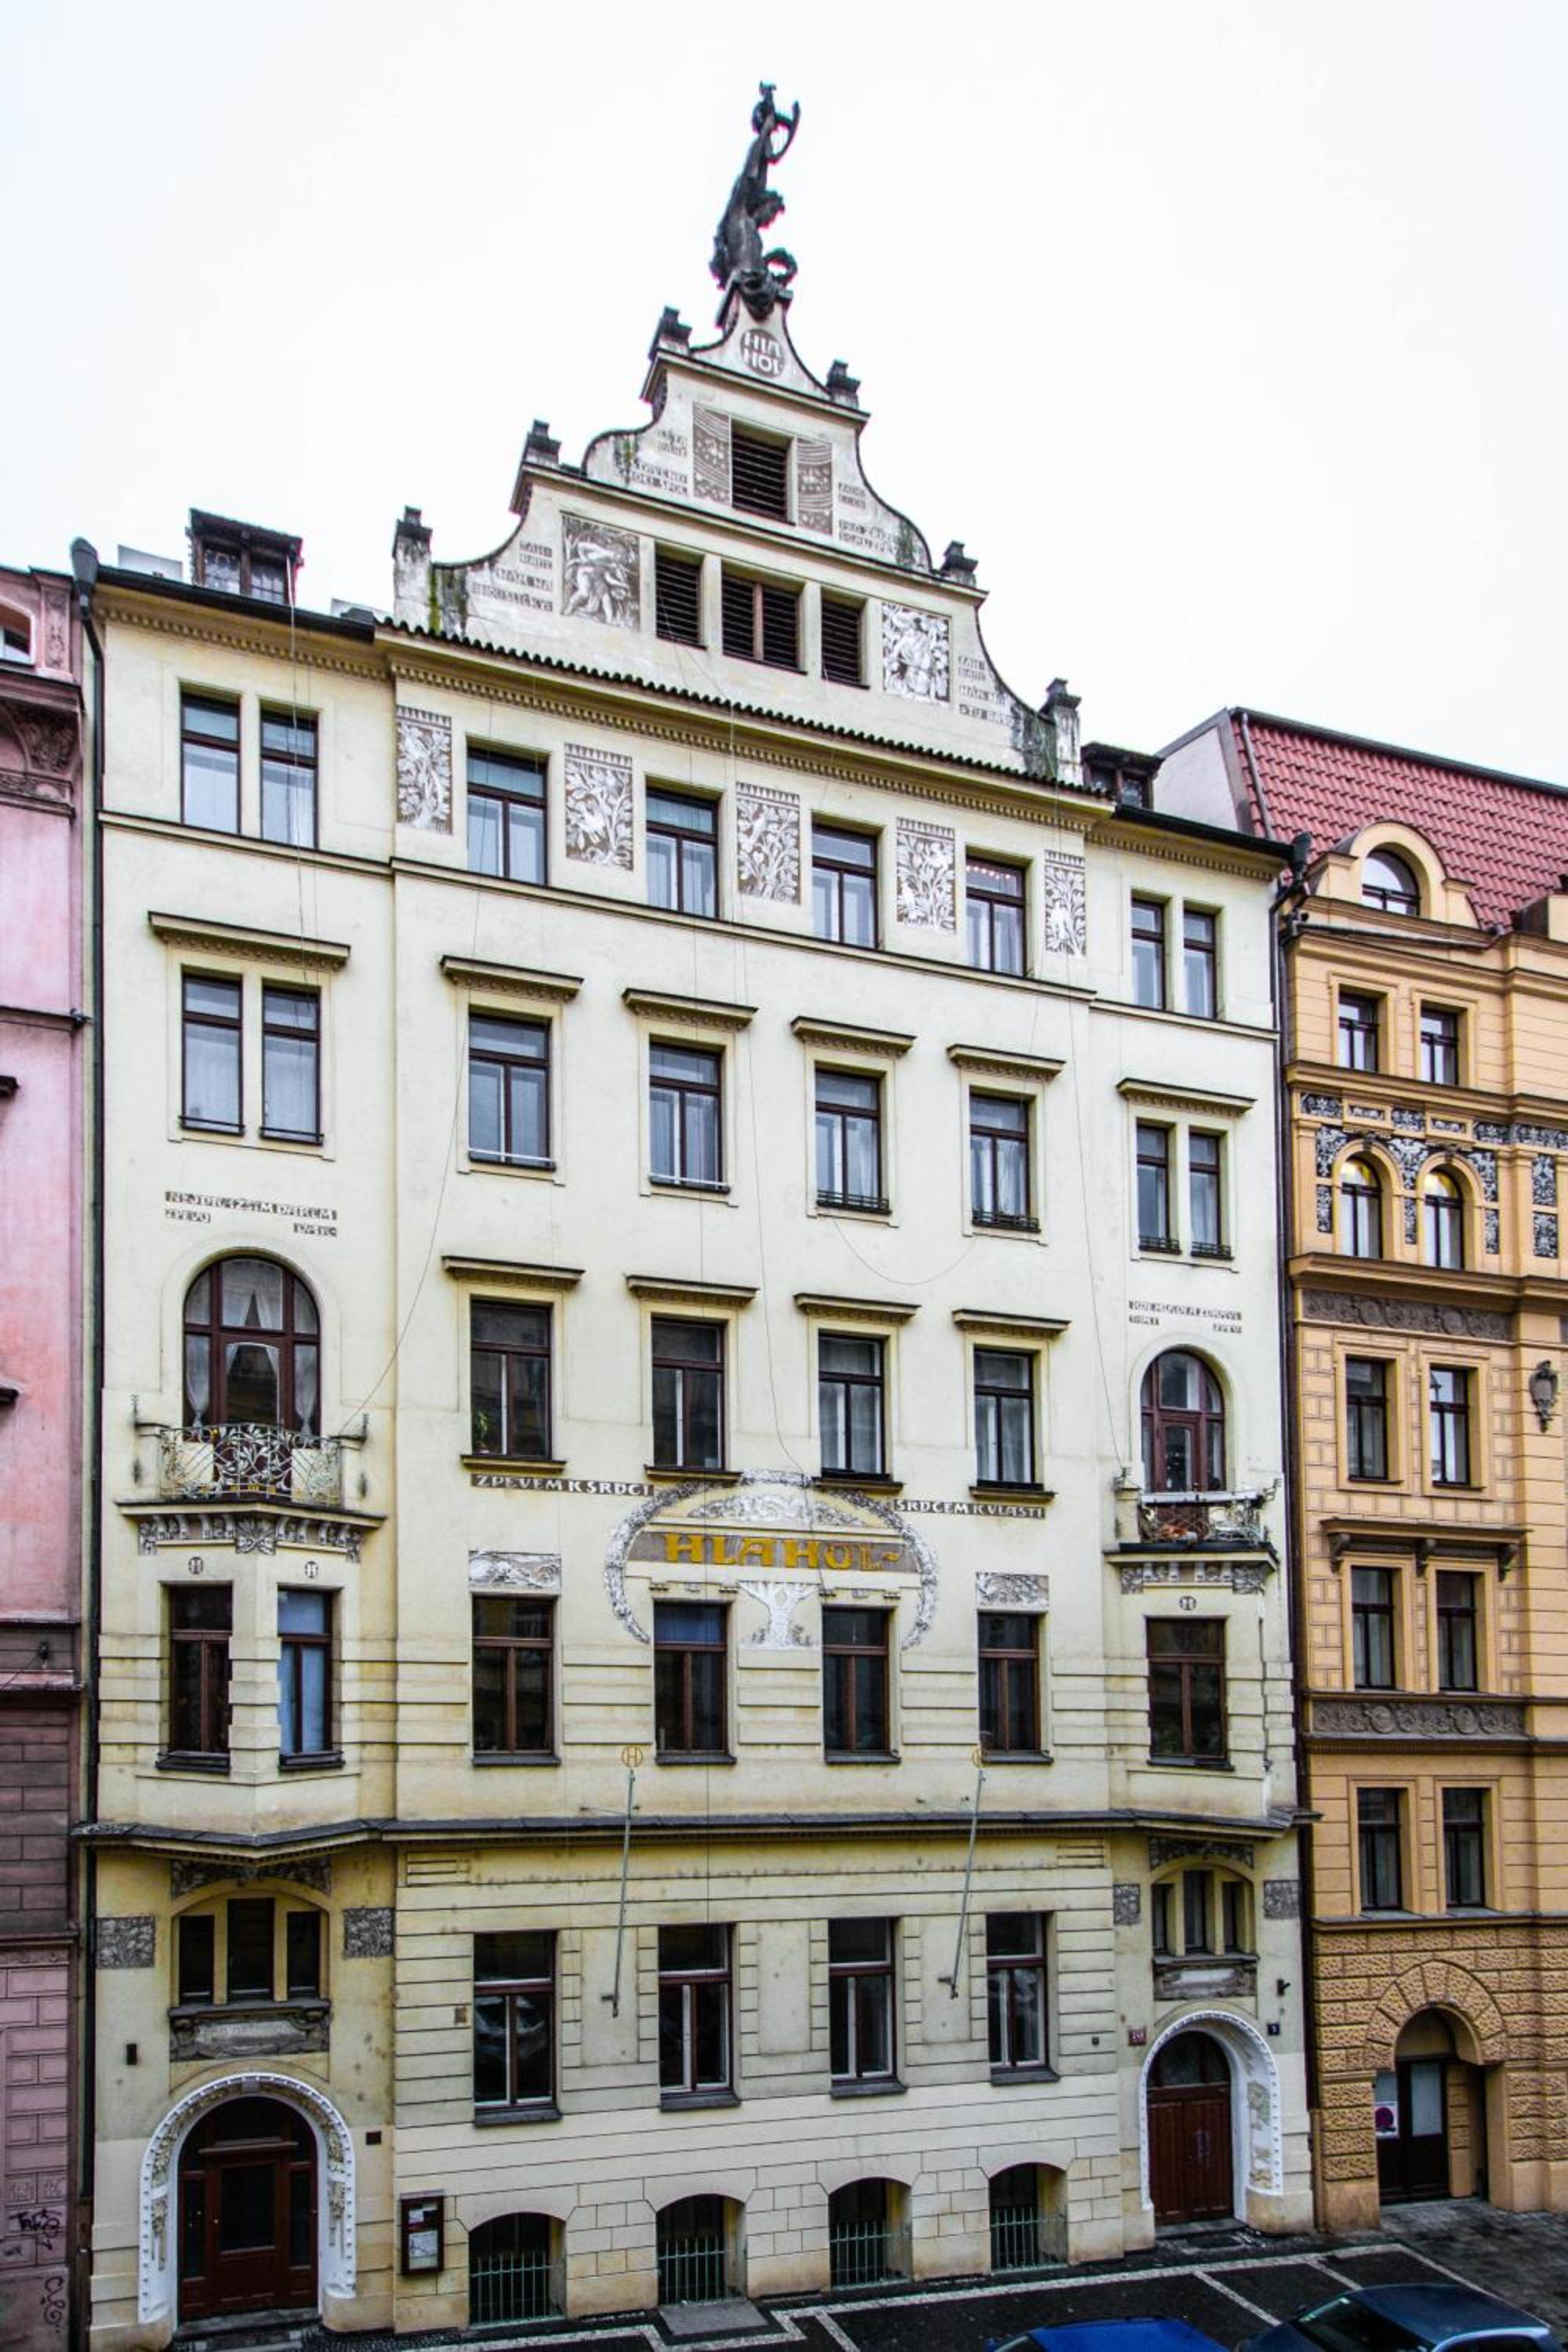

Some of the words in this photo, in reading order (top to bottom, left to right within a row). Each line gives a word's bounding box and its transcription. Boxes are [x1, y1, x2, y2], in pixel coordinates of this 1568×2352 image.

[568, 1480, 583, 1493] K
[586, 1481, 649, 1497] SRDCI
[896, 1499, 969, 1515] SRDCEM
[987, 1504, 1042, 1519] VLASTI
[664, 1533, 883, 1572] HLAHOL
